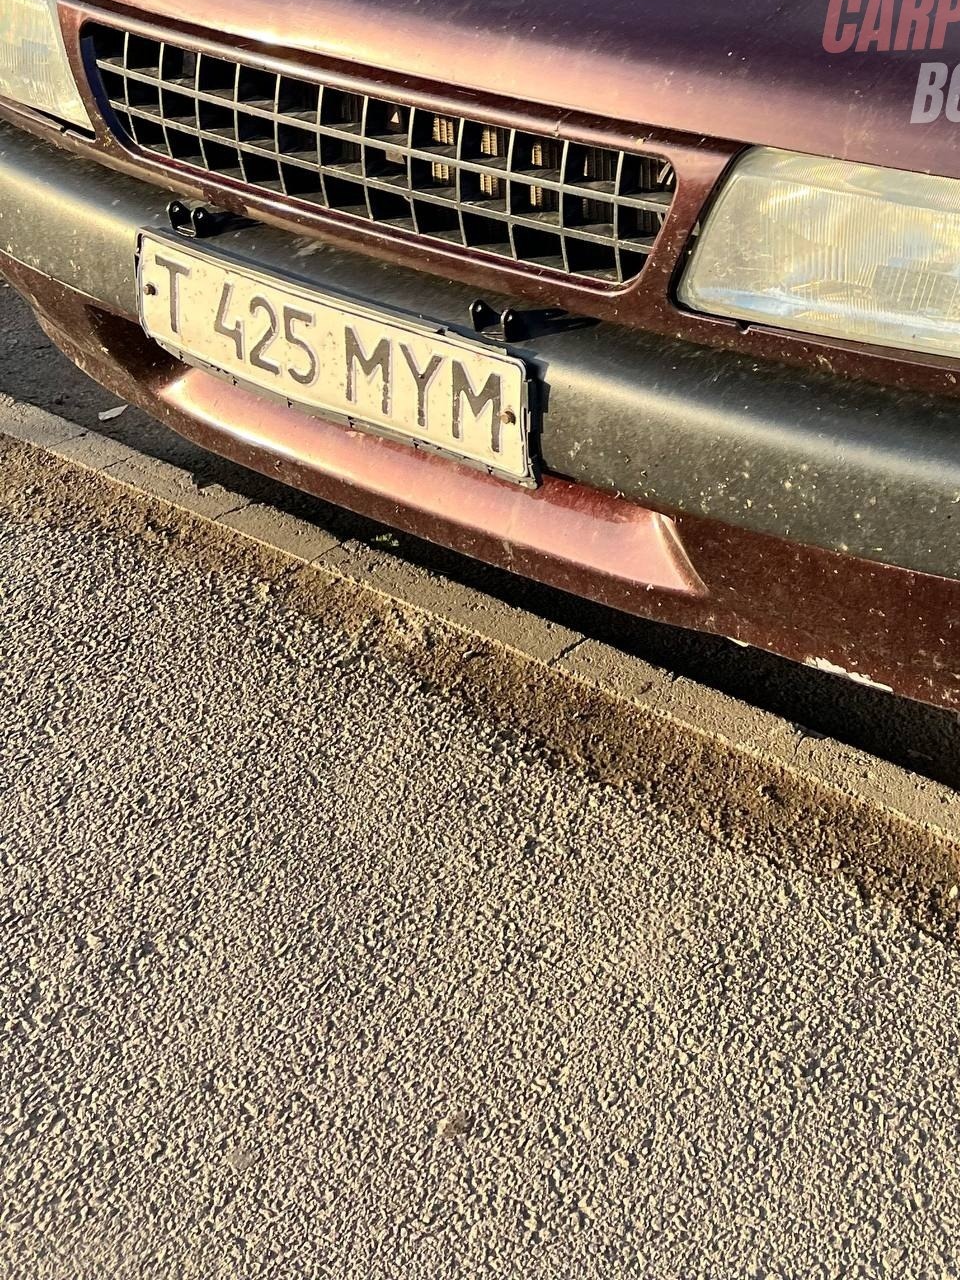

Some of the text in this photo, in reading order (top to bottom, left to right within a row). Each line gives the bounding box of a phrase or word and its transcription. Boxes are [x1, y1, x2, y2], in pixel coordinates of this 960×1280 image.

[155, 254, 504, 454] T 425 MYM
